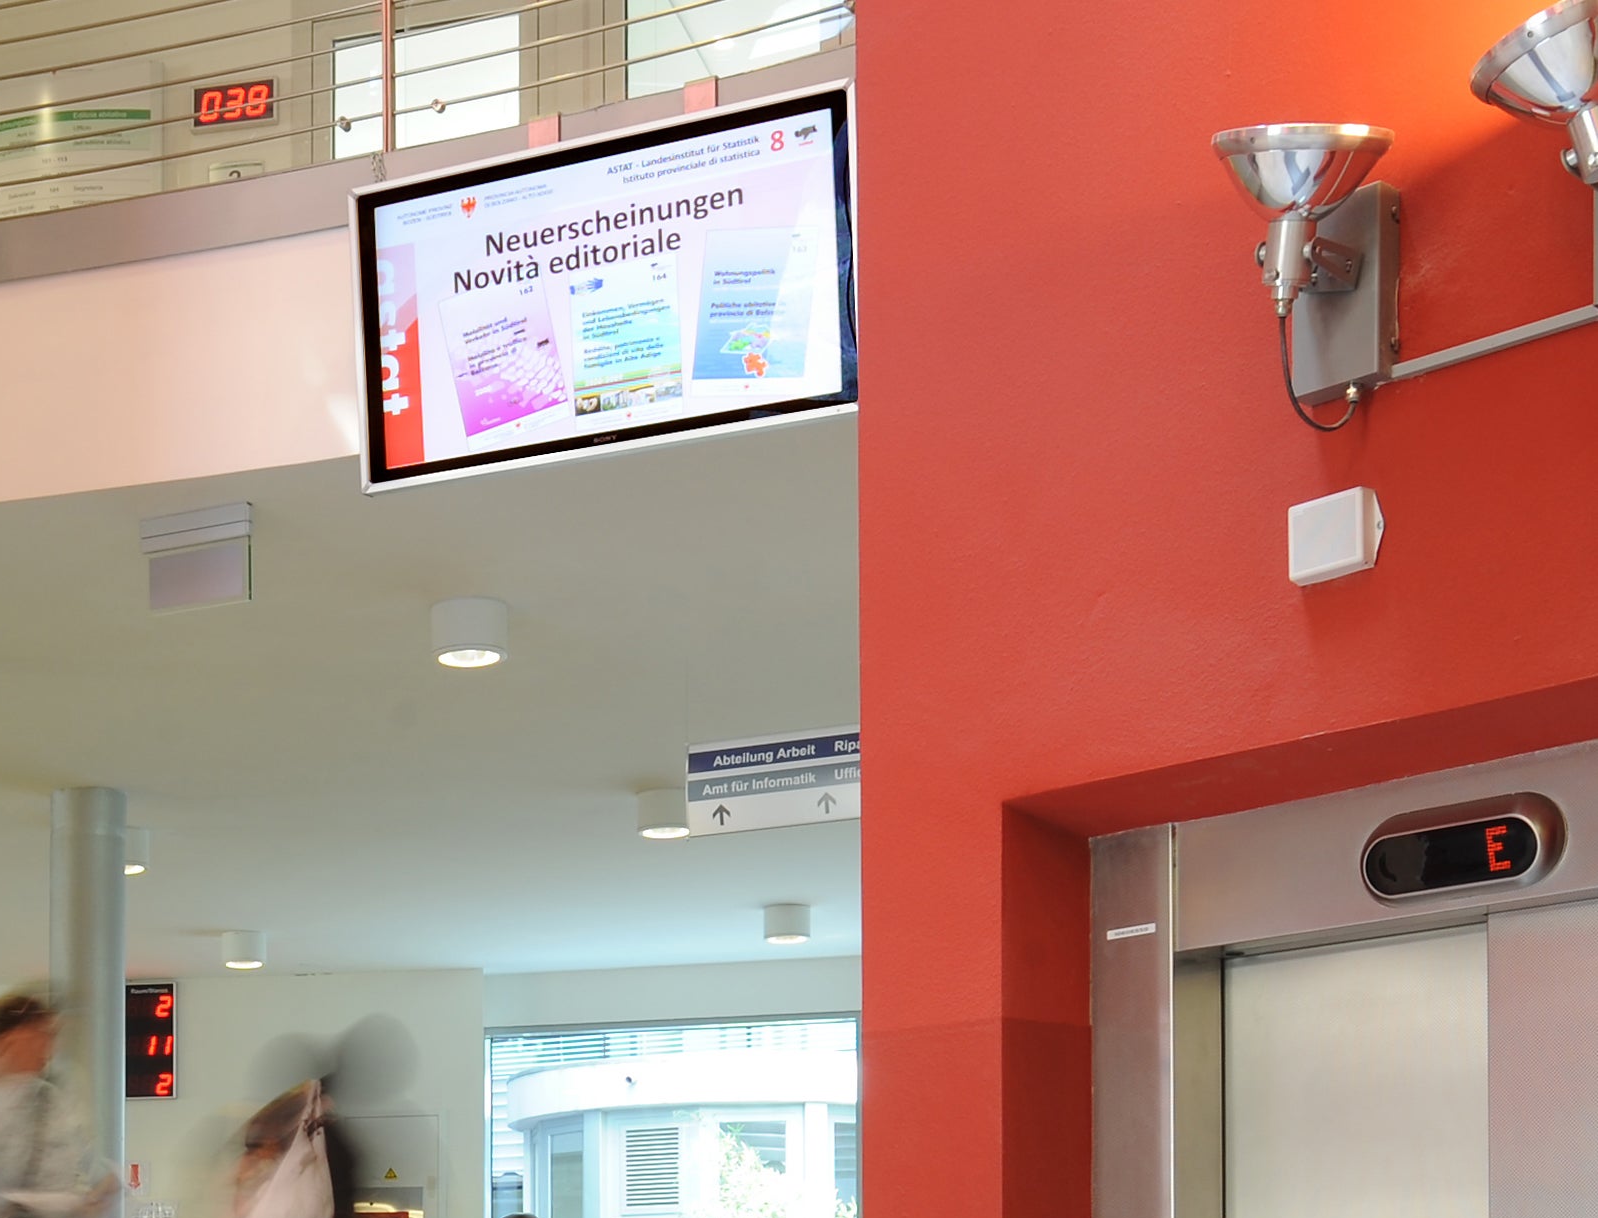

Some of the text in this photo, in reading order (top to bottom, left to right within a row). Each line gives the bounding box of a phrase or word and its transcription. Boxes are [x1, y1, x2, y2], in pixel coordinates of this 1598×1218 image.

[199, 84, 270, 123] 038
[770, 130, 785, 151] 8
[607, 162, 634, 176] ASTAT
[641, 147, 705, 169] Landesinstitut
[707, 143, 720, 154] für
[722, 136, 760, 151] Statistik
[622, 148, 761, 184] Istituto provinciale di statistica
[485, 187, 744, 257] Neuerscheinungen
[454, 228, 682, 294] Novità editoriale
[713, 744, 816, 768] Abteilung Arbeit
[702, 772, 817, 797] Amt für Informatik
[1485, 825, 1511, 872] E
[155, 995, 174, 1018] 2
[148, 1035, 174, 1056] 11
[155, 1073, 174, 1096] 2
